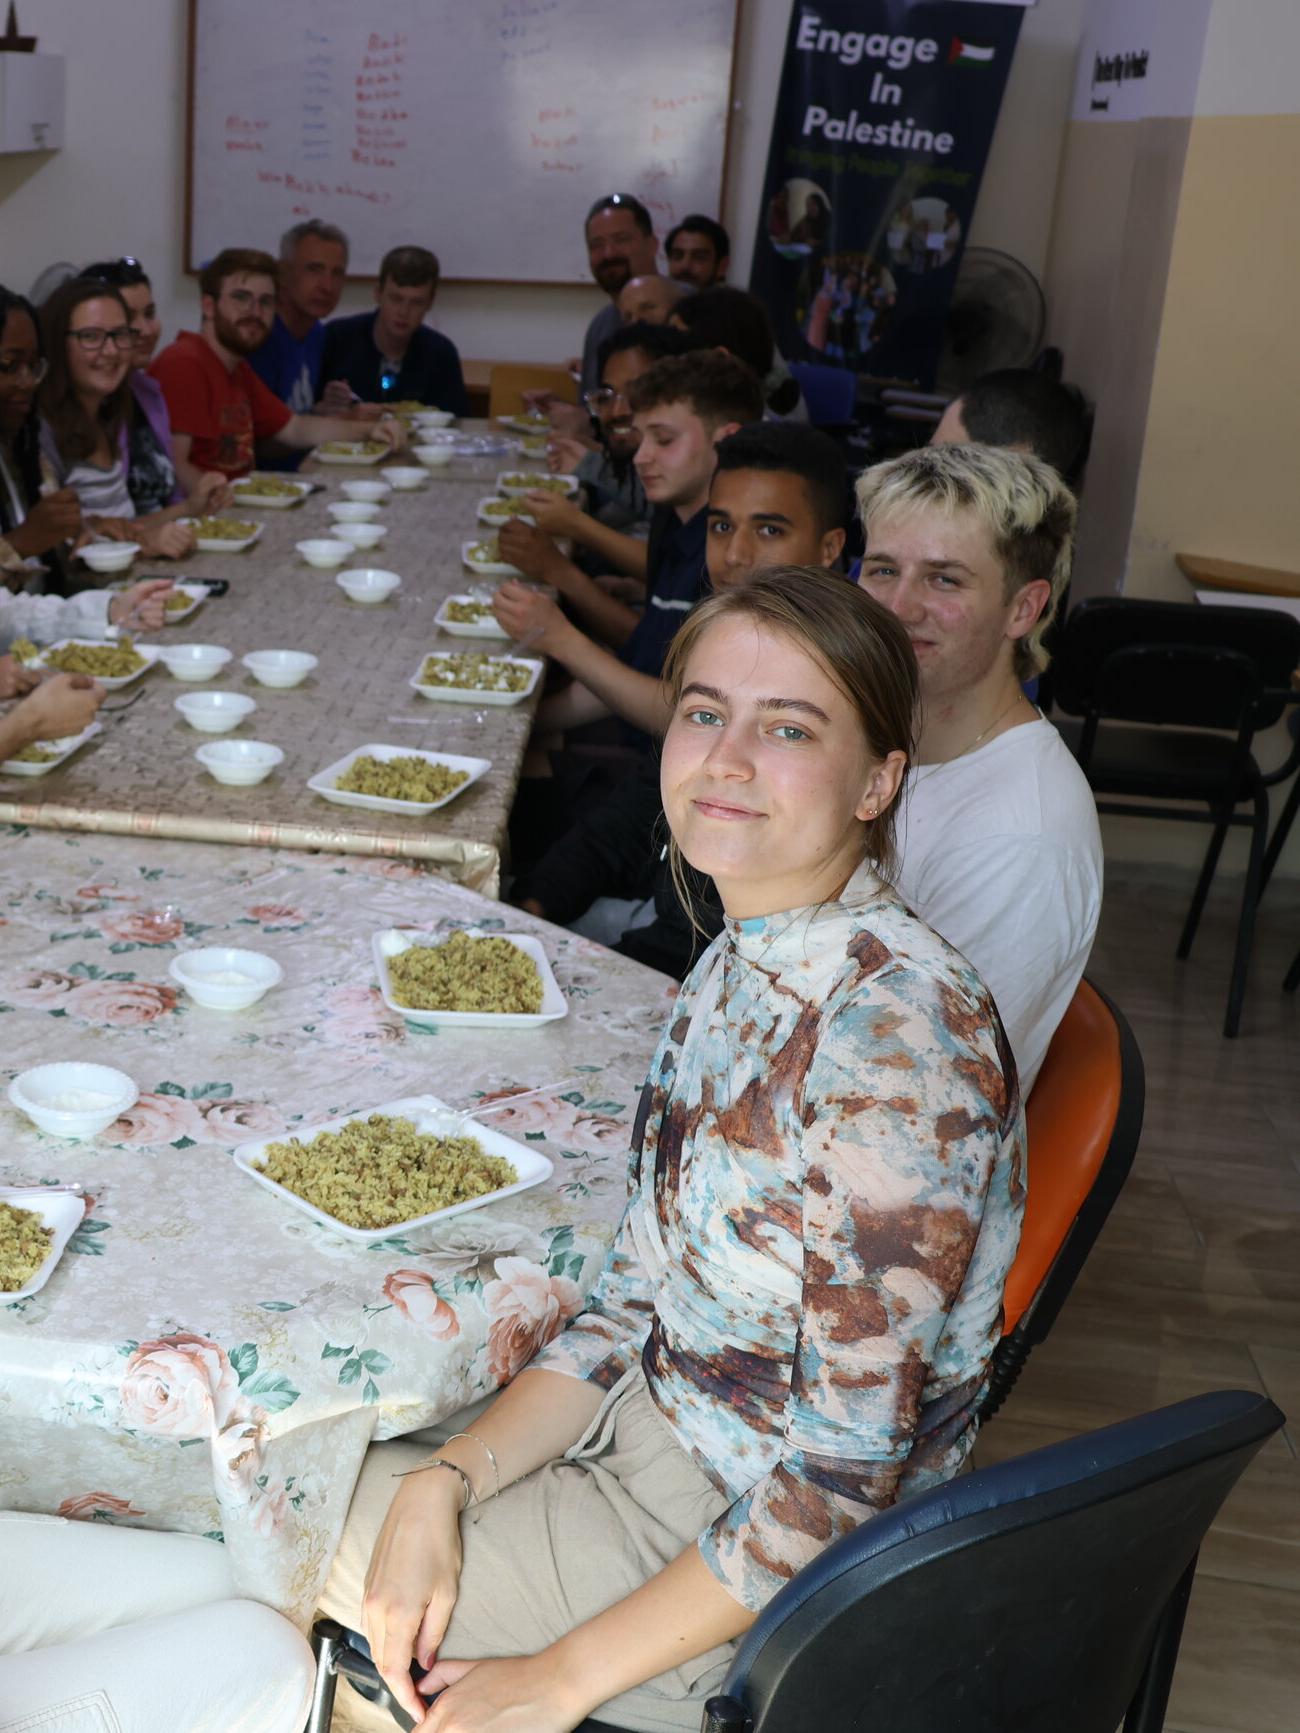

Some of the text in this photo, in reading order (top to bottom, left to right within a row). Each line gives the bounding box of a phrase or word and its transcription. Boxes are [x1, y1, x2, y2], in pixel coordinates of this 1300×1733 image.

[796, 15, 939, 70] Engage
[870, 72, 902, 105] In
[802, 105, 954, 154] Palestine
